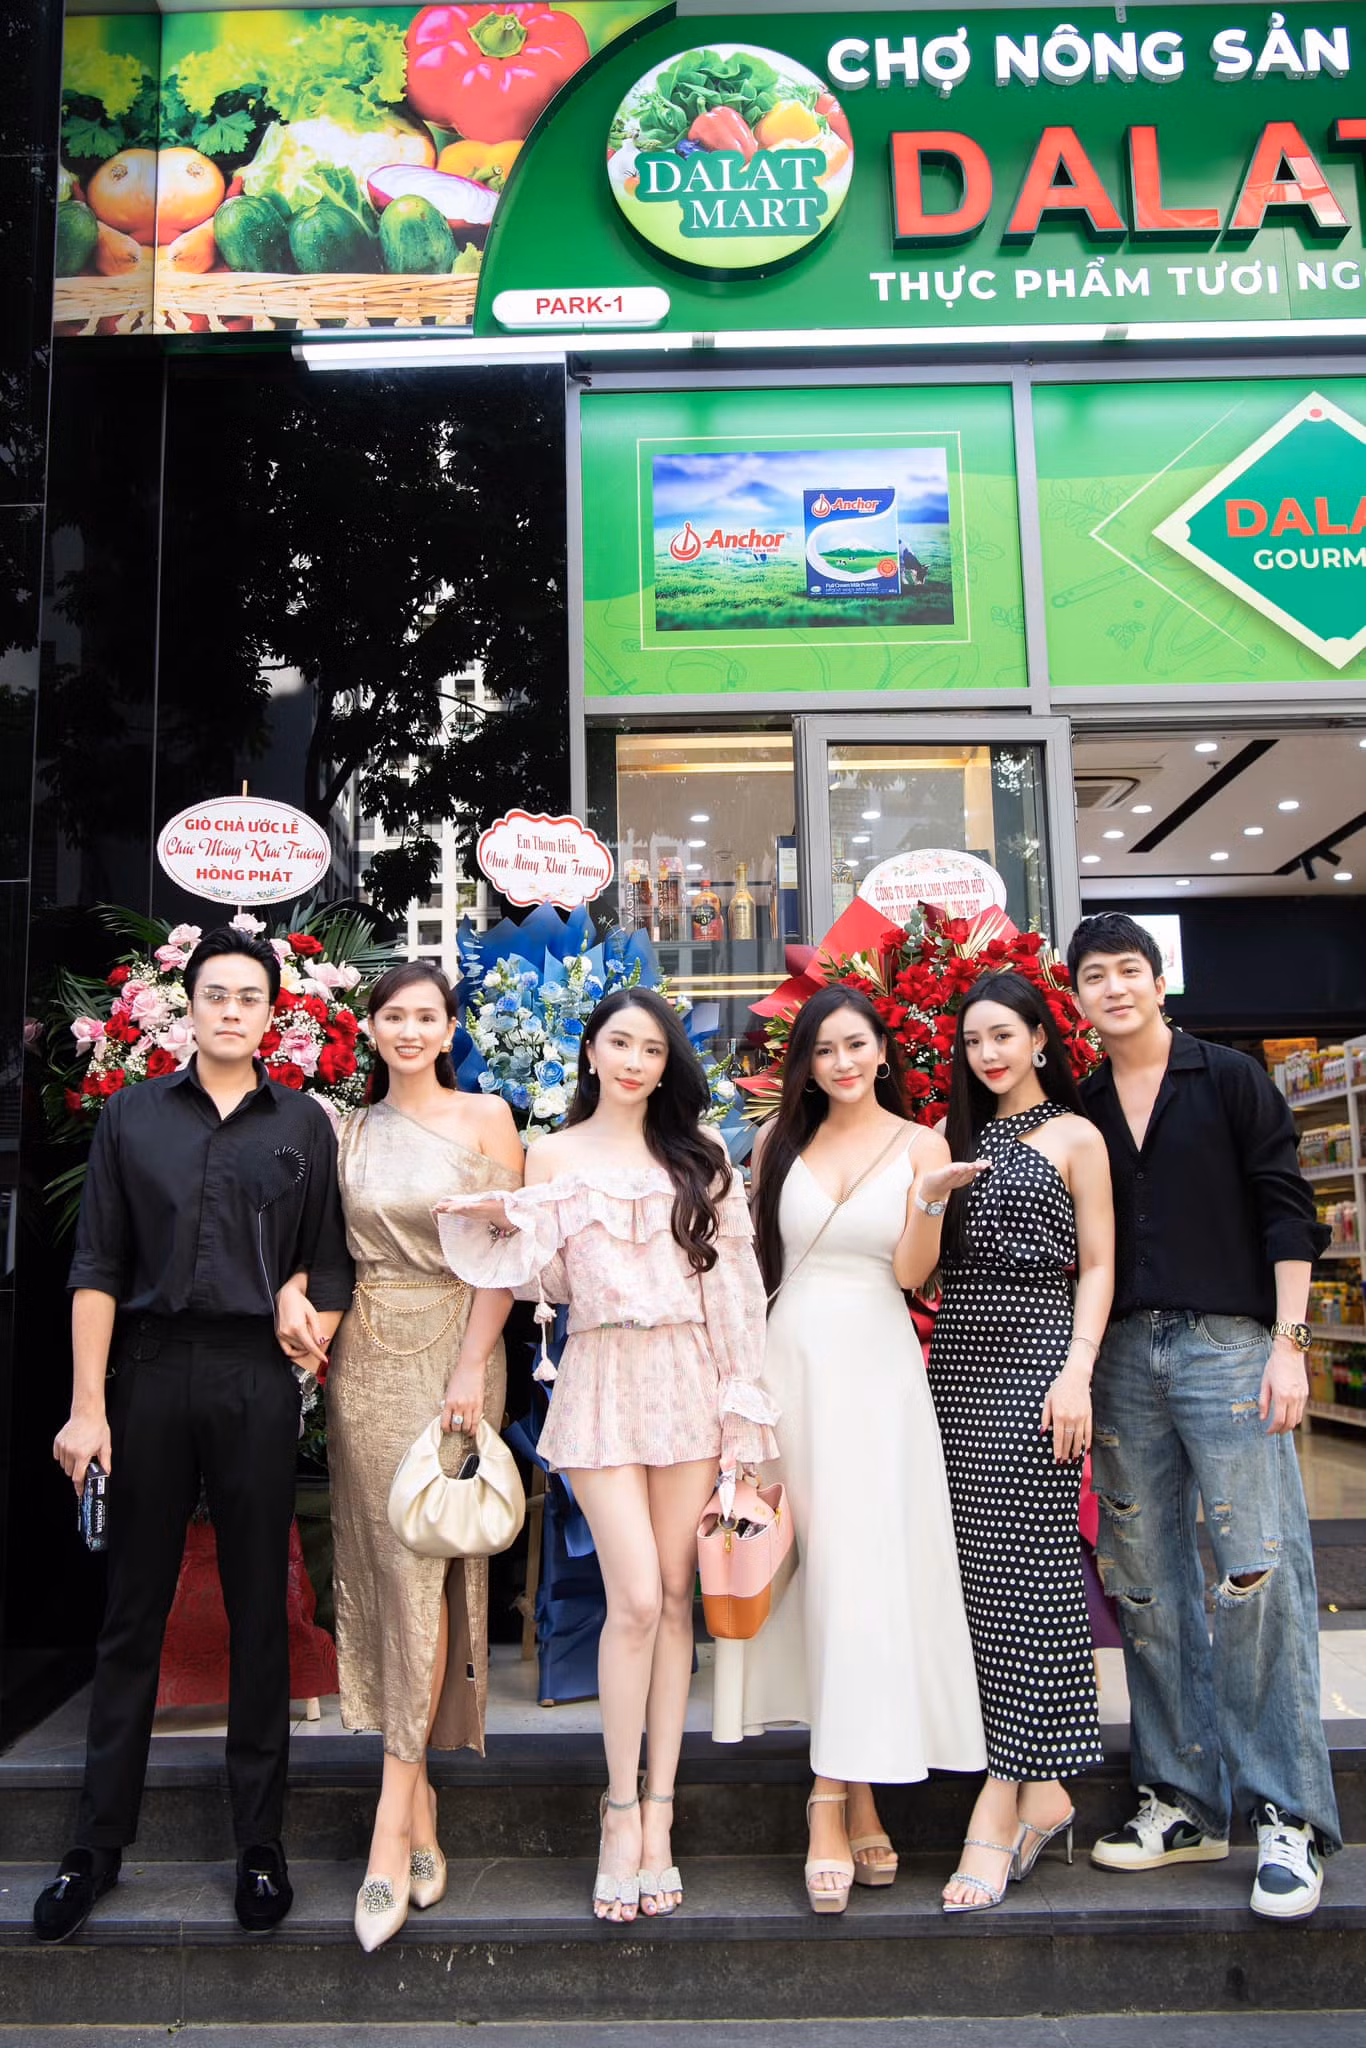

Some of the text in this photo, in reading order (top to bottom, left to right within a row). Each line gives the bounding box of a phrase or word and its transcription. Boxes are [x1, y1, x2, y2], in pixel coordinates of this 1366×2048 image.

[827, 12, 1350, 95] CHỢ NÔNG SẢN
[644, 157, 817, 194] DALAT
[688, 197, 818, 230] MART
[869, 256, 1366, 308] THỰC PHẨM TƯƠI NG
[535, 296, 623, 315] PARK-1
[831, 497, 879, 511] Anchor
[703, 528, 785, 549] Anchor
[185, 816, 300, 834] GIÒ CHẢ ƯỚC LỄ
[166, 836, 195, 856] Chúc
[199, 837, 241, 865] Mừng
[245, 839, 282, 862] Khai
[516, 833, 531, 849] Em
[196, 863, 293, 883] HỒNG PHÁT
[543, 856, 567, 874] Khai
[626, 883, 634, 924] CHOYA
